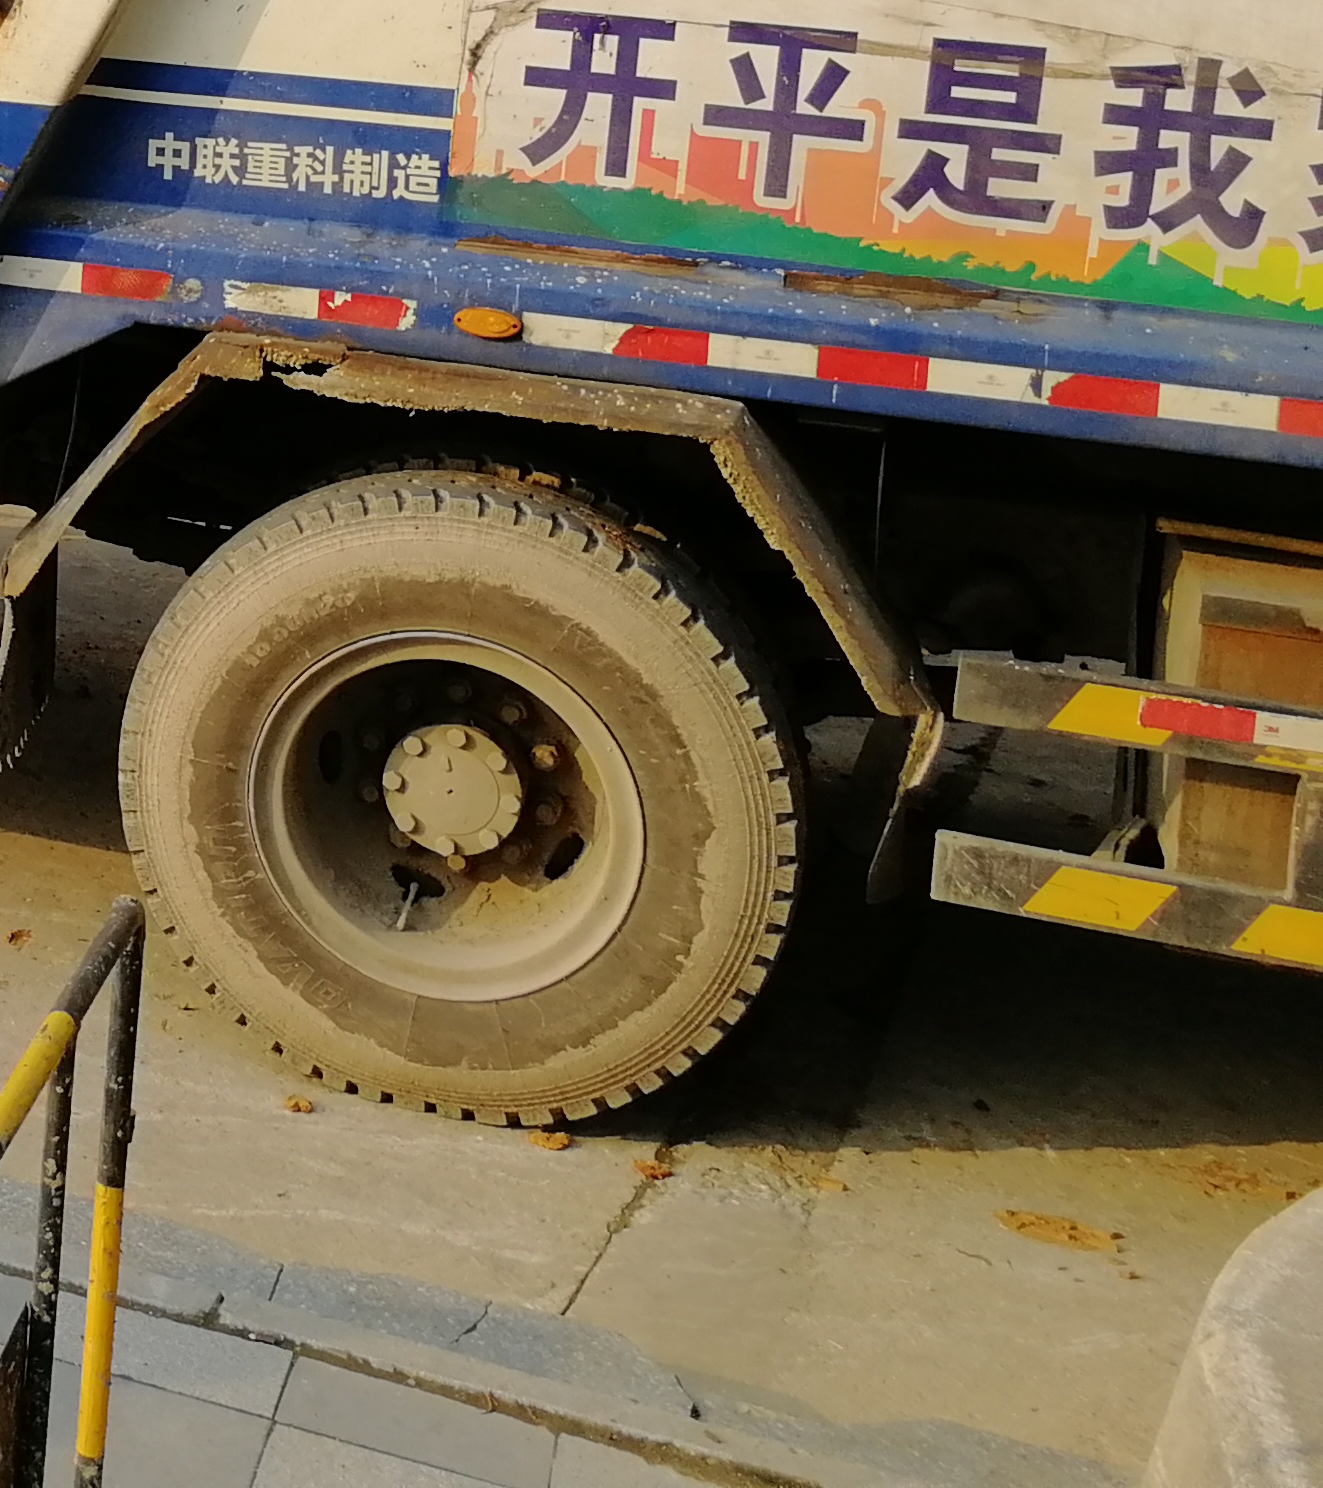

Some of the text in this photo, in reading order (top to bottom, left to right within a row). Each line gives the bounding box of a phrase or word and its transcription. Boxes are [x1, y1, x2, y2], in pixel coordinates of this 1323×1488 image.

[147, 131, 441, 203] 中联重科制造
[518, 7, 1323, 254] 开平是我
